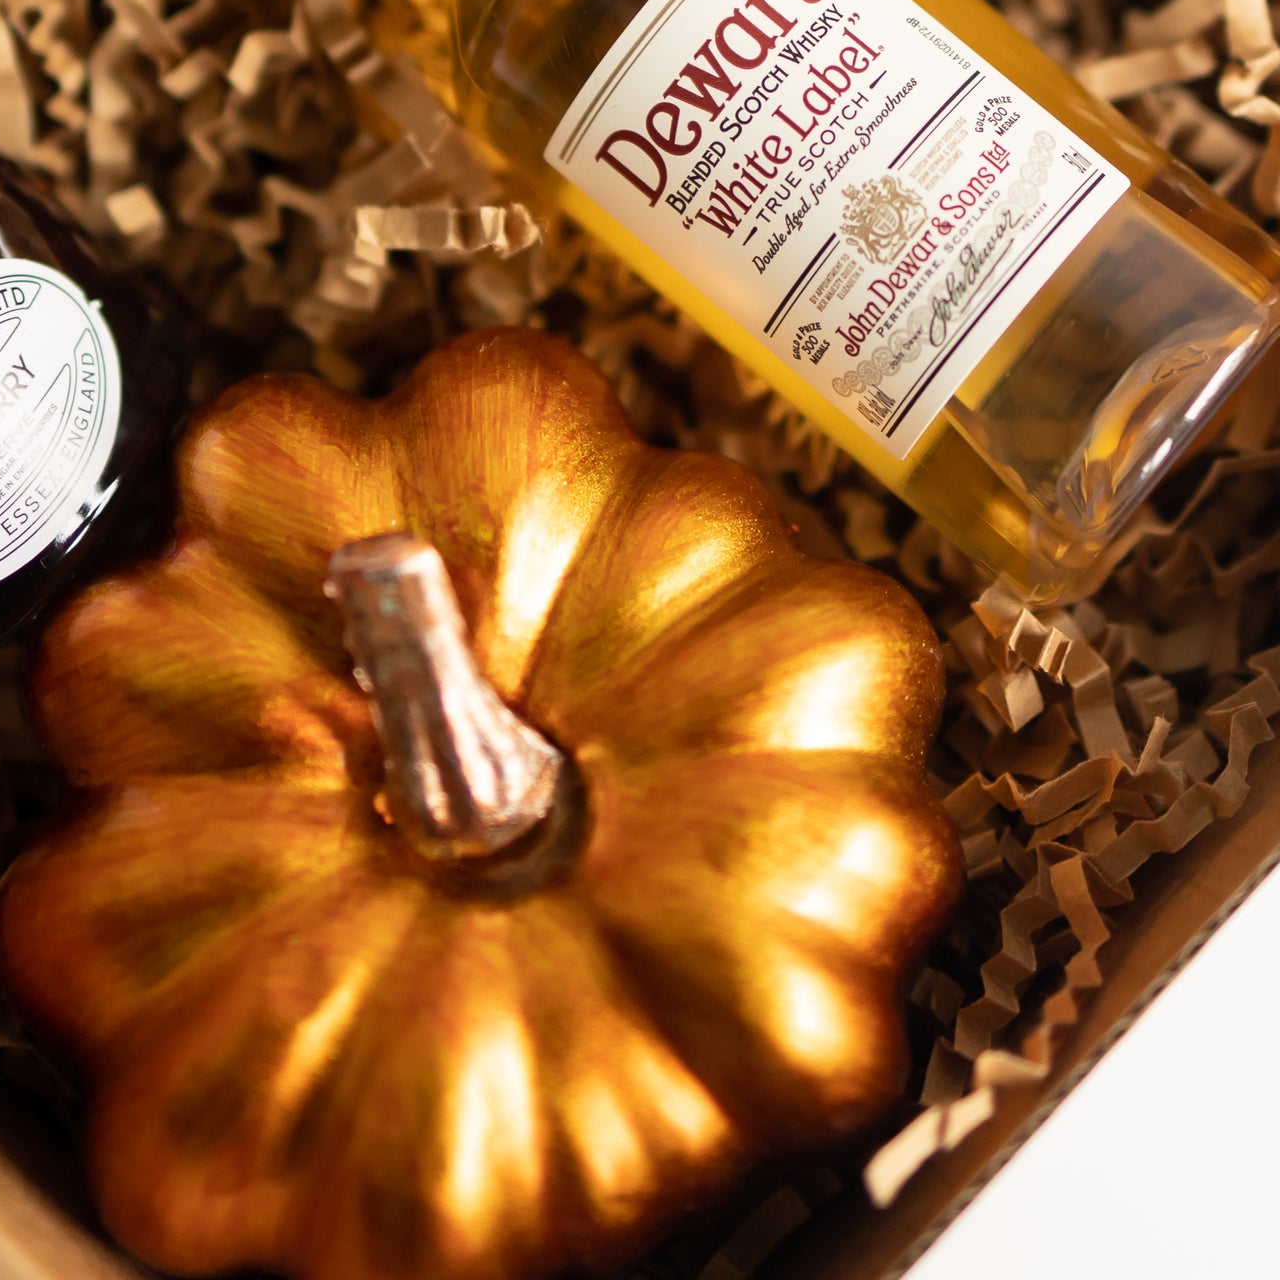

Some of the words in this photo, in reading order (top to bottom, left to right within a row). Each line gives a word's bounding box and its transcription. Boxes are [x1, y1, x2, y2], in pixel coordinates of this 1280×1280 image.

[905, 17, 971, 69] 8141029172-BP
[664, 140, 726, 215] BLENDED
[719, 64, 788, 142] SCOTCH
[777, 3, 843, 64] WHISKY
[974, 111, 985, 132] GOLD
[986, 95, 1012, 107] PRIZE
[987, 106, 1007, 126] 500
[994, 111, 1020, 136] MEDALS
[751, 232, 787, 274] Double
[784, 196, 811, 235] Aged
[809, 178, 826, 205] for
[823, 143, 858, 181] Extra
[854, 77, 917, 149] Smoothness
[755, 170, 802, 222] TRUE
[798, 91, 868, 172] SCOTCH
[979, 140, 1010, 173] Ltd
[938, 166, 995, 219] Sons
[930, 216, 955, 235] &
[943, 189, 1000, 254] SCOTLAND
[814, 260, 843, 297] APPOINTMENT
[823, 277, 843, 301] MAJESTY
[840, 259, 857, 279] QUEEN
[866, 229, 938, 308] Dewar
[792, 339, 801, 360] GOLD
[797, 322, 821, 335] PRIZE
[800, 334, 818, 354] 500
[834, 301, 885, 357] John
[809, 339, 830, 364] MEDALS
[0, 468, 63, 536] ESSEX
[65, 352, 95, 462] ENGLAND
[4, 480, 13, 490] IN
